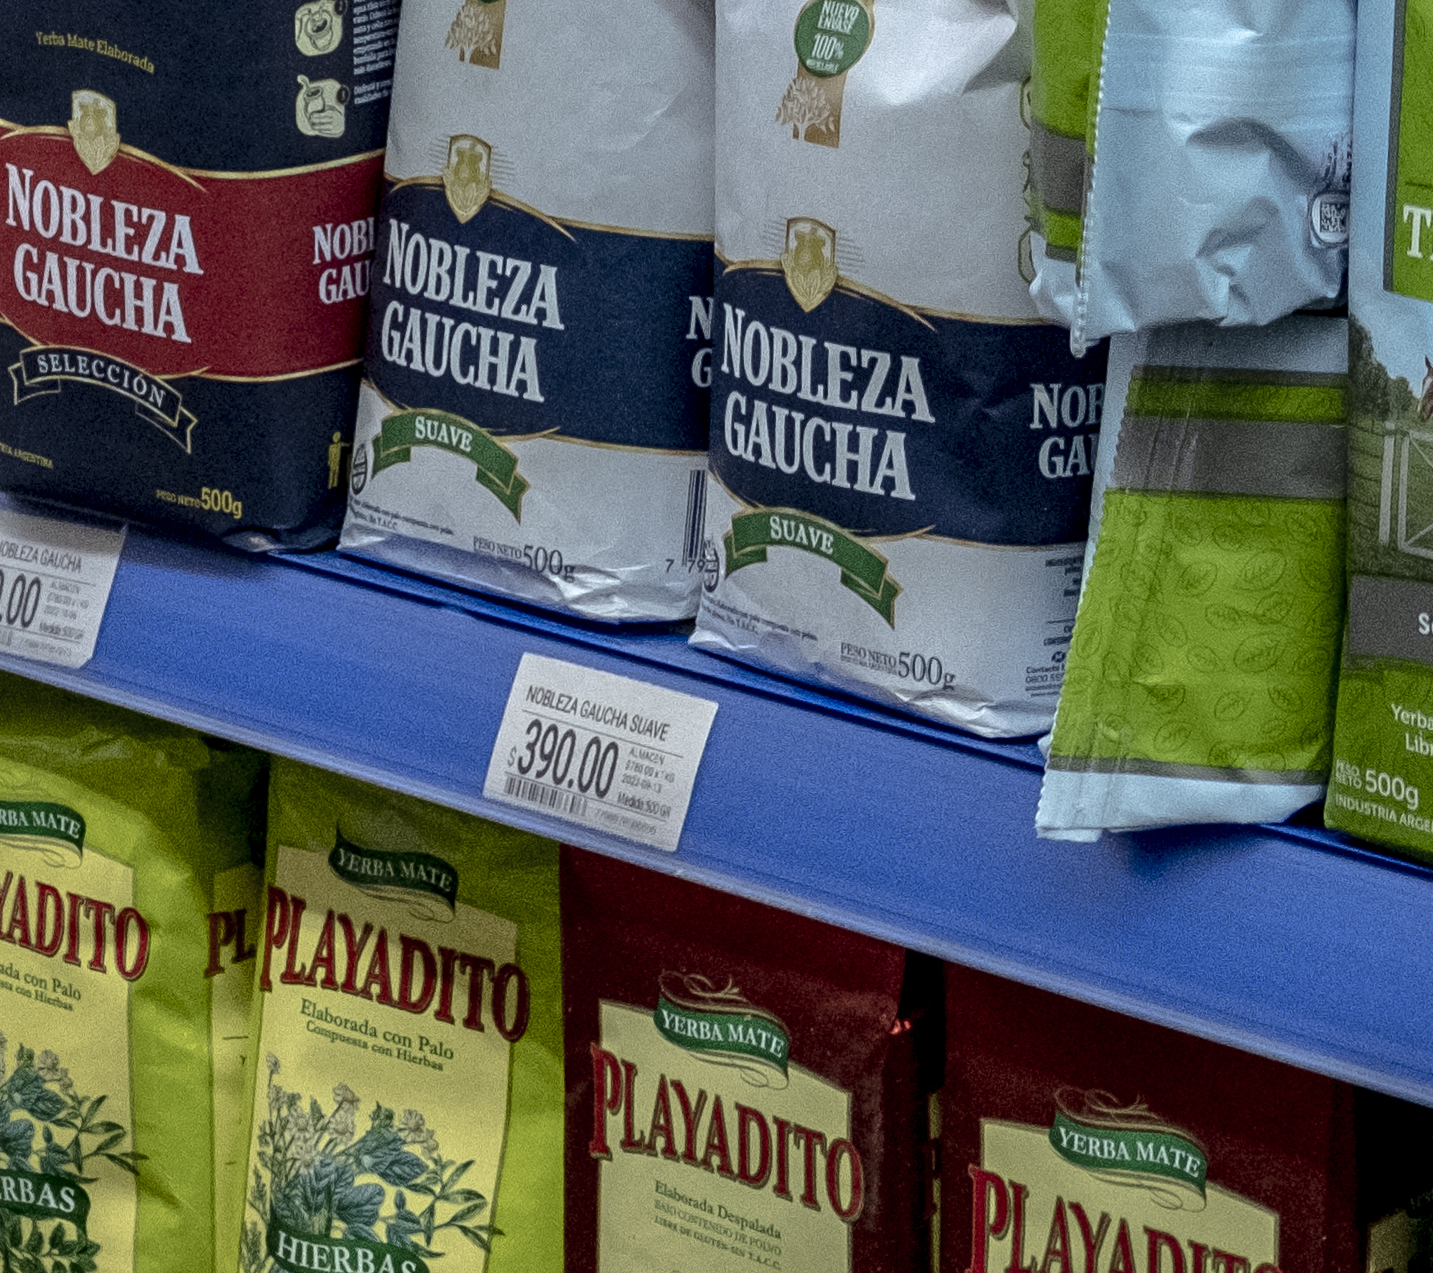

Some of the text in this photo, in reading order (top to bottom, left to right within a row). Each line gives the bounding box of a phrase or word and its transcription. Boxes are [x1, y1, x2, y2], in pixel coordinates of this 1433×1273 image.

[5, 164, 204, 275] NOBLEZA
[14, 245, 192, 345] GAUCHA
[387, 218, 565, 333] NOBLEZA
[380, 304, 544, 403] GAUCHA
[723, 302, 935, 425] NOBLEZA
[724, 394, 916, 501] GAUCHA
[769, 516, 836, 554] SUAVE
[526, 686, 669, 741] NOBLEZA GAUCHA SUAVE
[264, 881, 530, 1044] PLAYADITO
[660, 1012, 785, 1057] YERBA MATE
[591, 1043, 864, 1222] PLAYADITO
